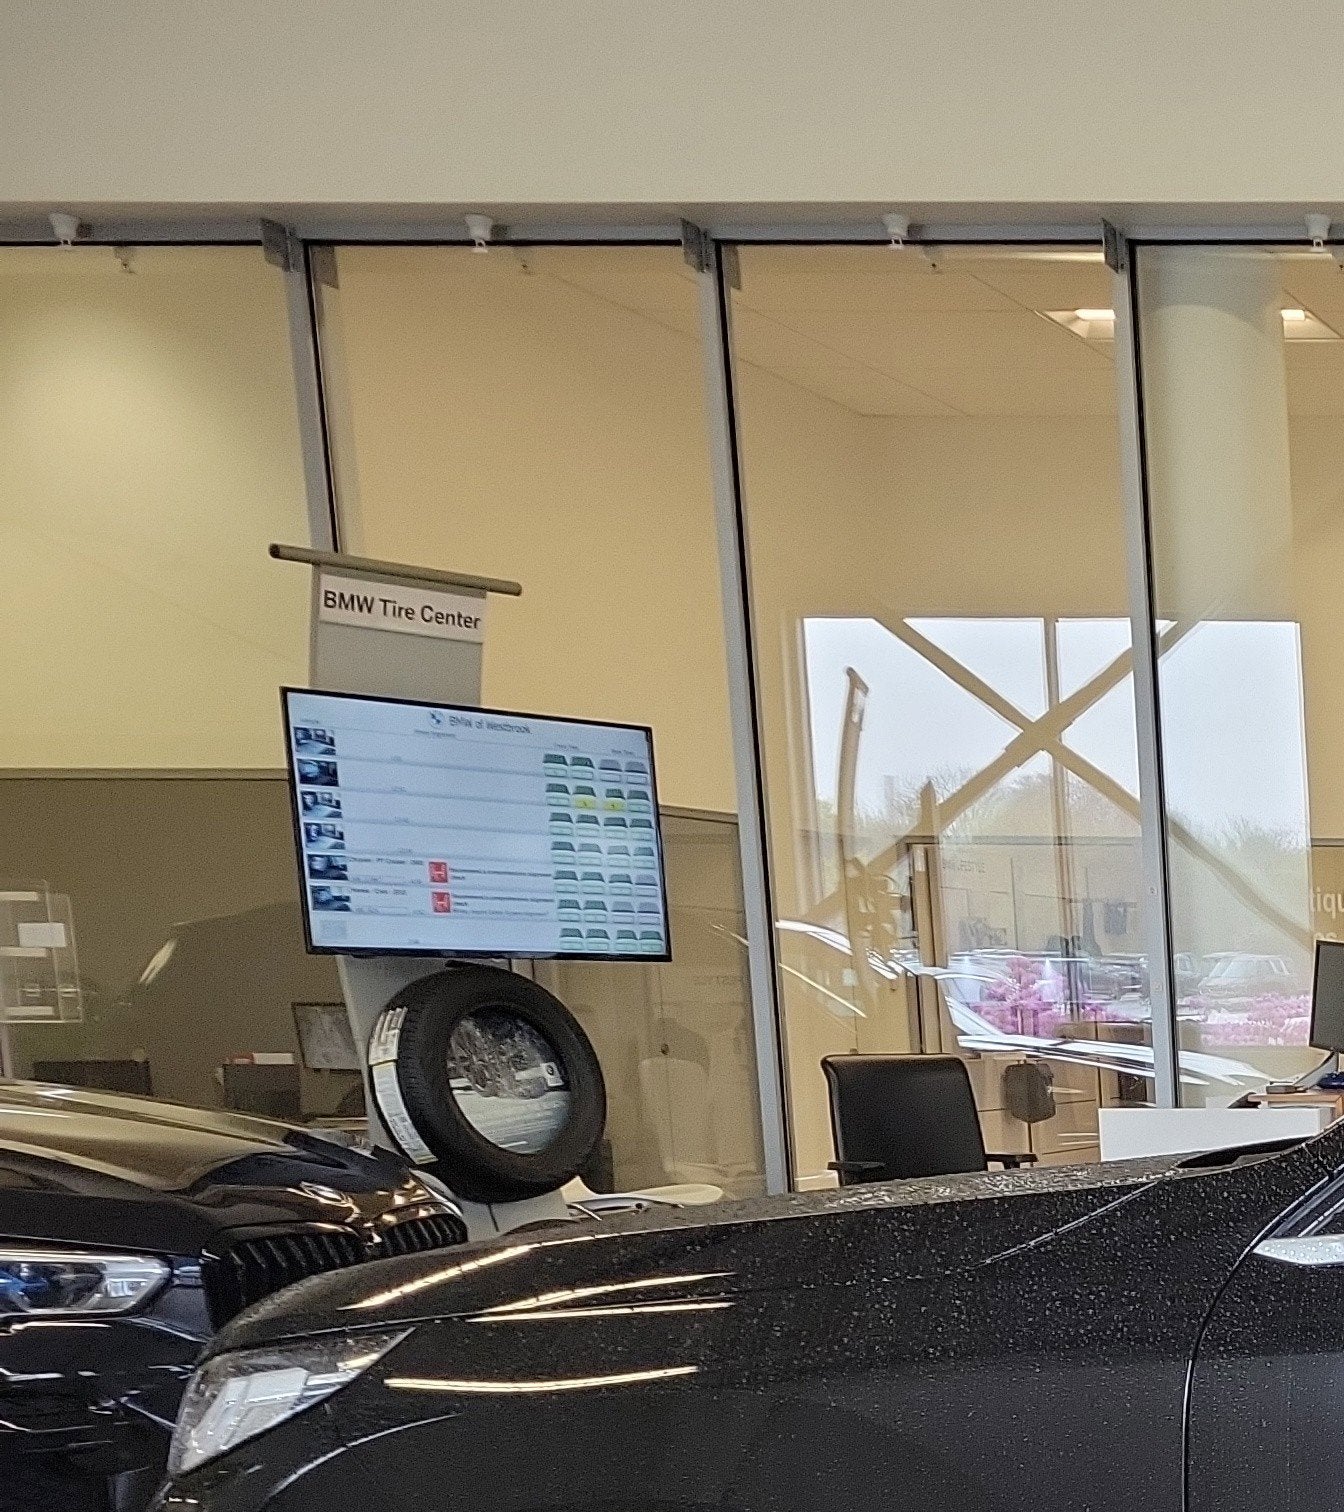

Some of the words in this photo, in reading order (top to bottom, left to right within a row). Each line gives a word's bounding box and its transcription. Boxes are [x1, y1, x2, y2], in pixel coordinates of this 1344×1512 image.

[323, 589, 375, 614] BMW
[378, 597, 416, 621] Tire
[420, 605, 482, 629] Center
